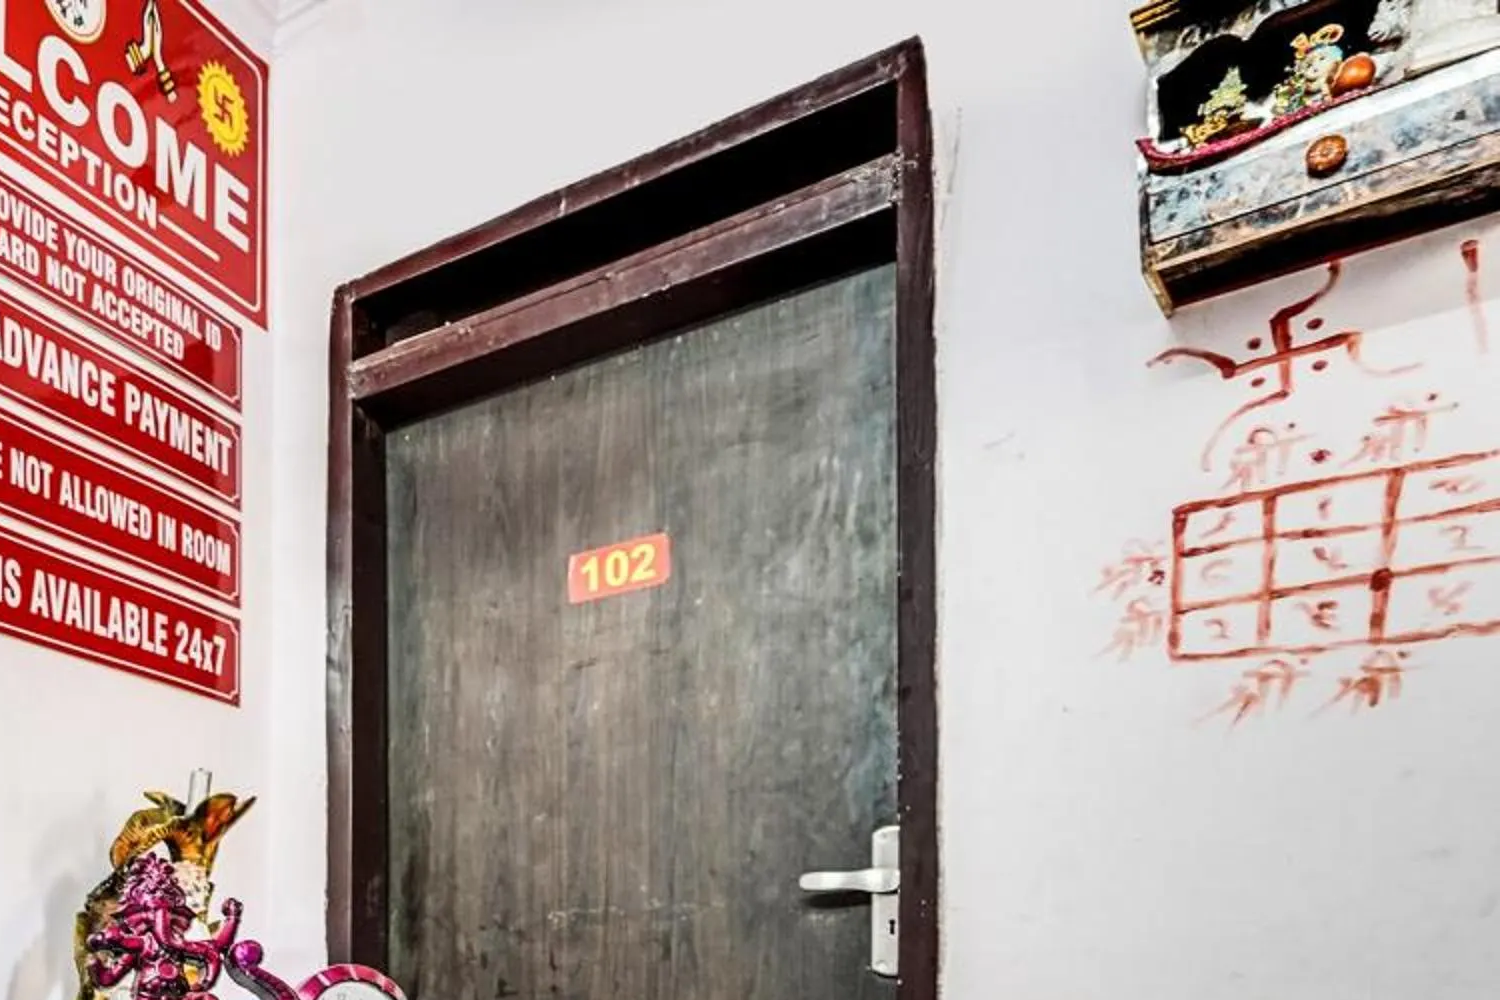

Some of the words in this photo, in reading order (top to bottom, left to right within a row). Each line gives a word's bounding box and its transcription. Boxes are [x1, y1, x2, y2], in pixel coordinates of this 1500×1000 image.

[46, 254, 86, 303] NOT
[92, 283, 185, 362] ACCEPTED
[62, 228, 117, 287] YOUR
[122, 266, 202, 341] ORIGINAL
[205, 319, 222, 352] ID
[124, 381, 232, 477] PAYMENT
[10, 447, 54, 500] NOT
[59, 471, 152, 541] ALLOWED
[157, 511, 177, 552] IN
[181, 522, 231, 577] ROOM
[580, 543, 657, 593] 102
[30, 568, 169, 658] AVAILABLE
[174, 619, 227, 677] 24x7
